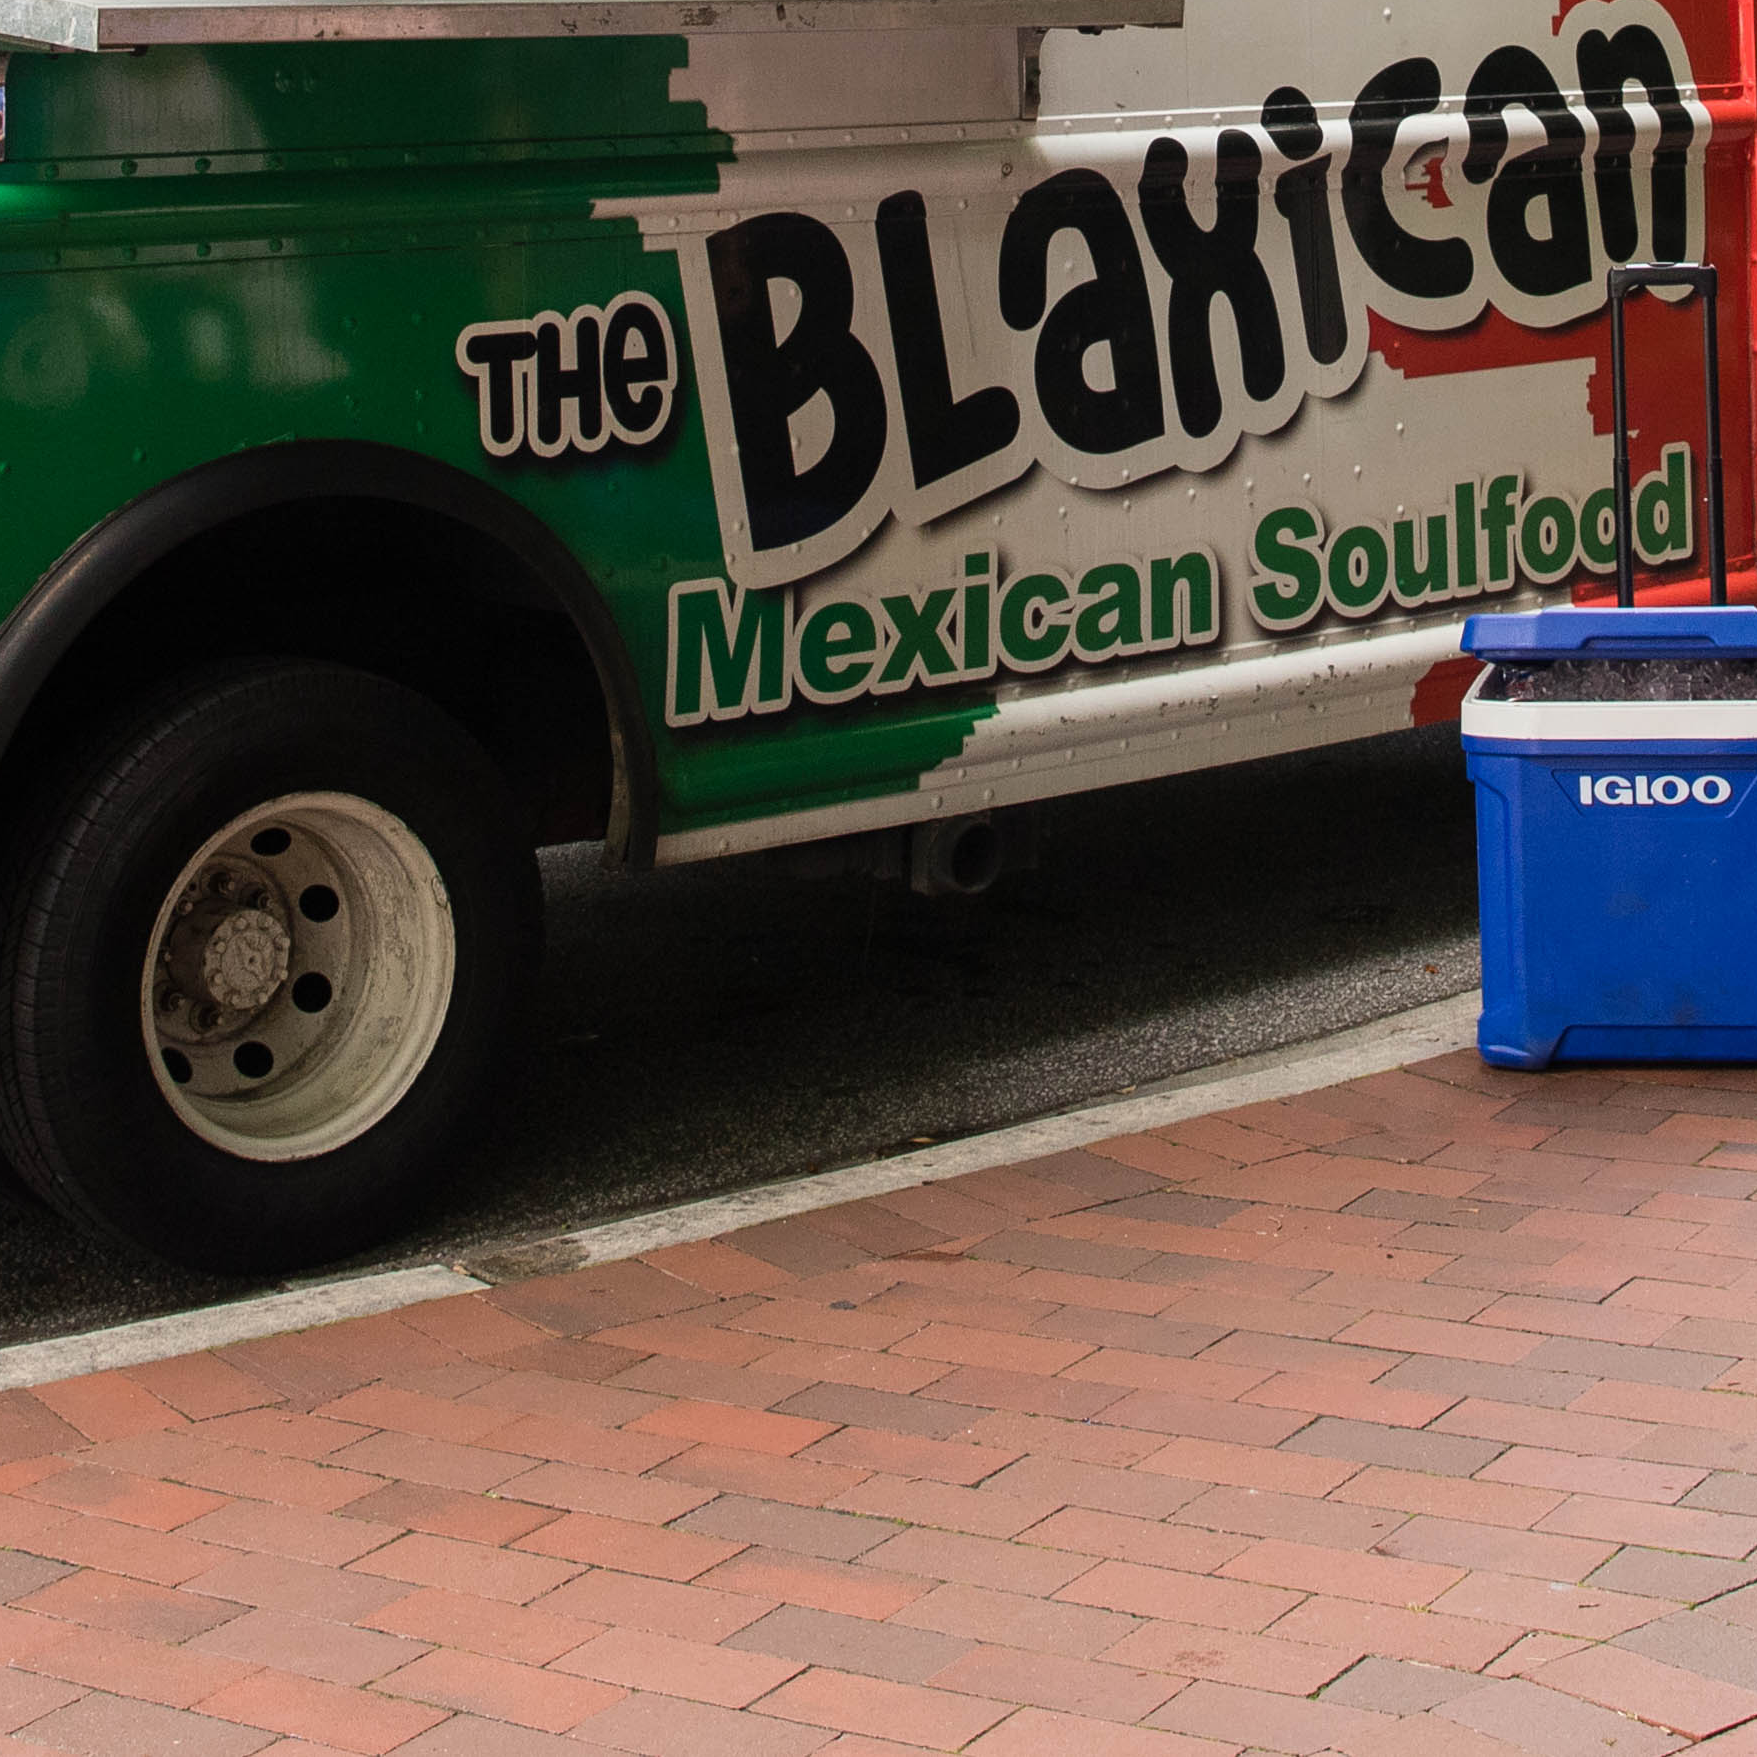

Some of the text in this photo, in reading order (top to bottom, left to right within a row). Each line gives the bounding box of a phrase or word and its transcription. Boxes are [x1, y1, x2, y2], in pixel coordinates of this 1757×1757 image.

[674, 448, 1690, 718] Mexican Soulfood
[1578, 775, 1734, 807] IGLOO
